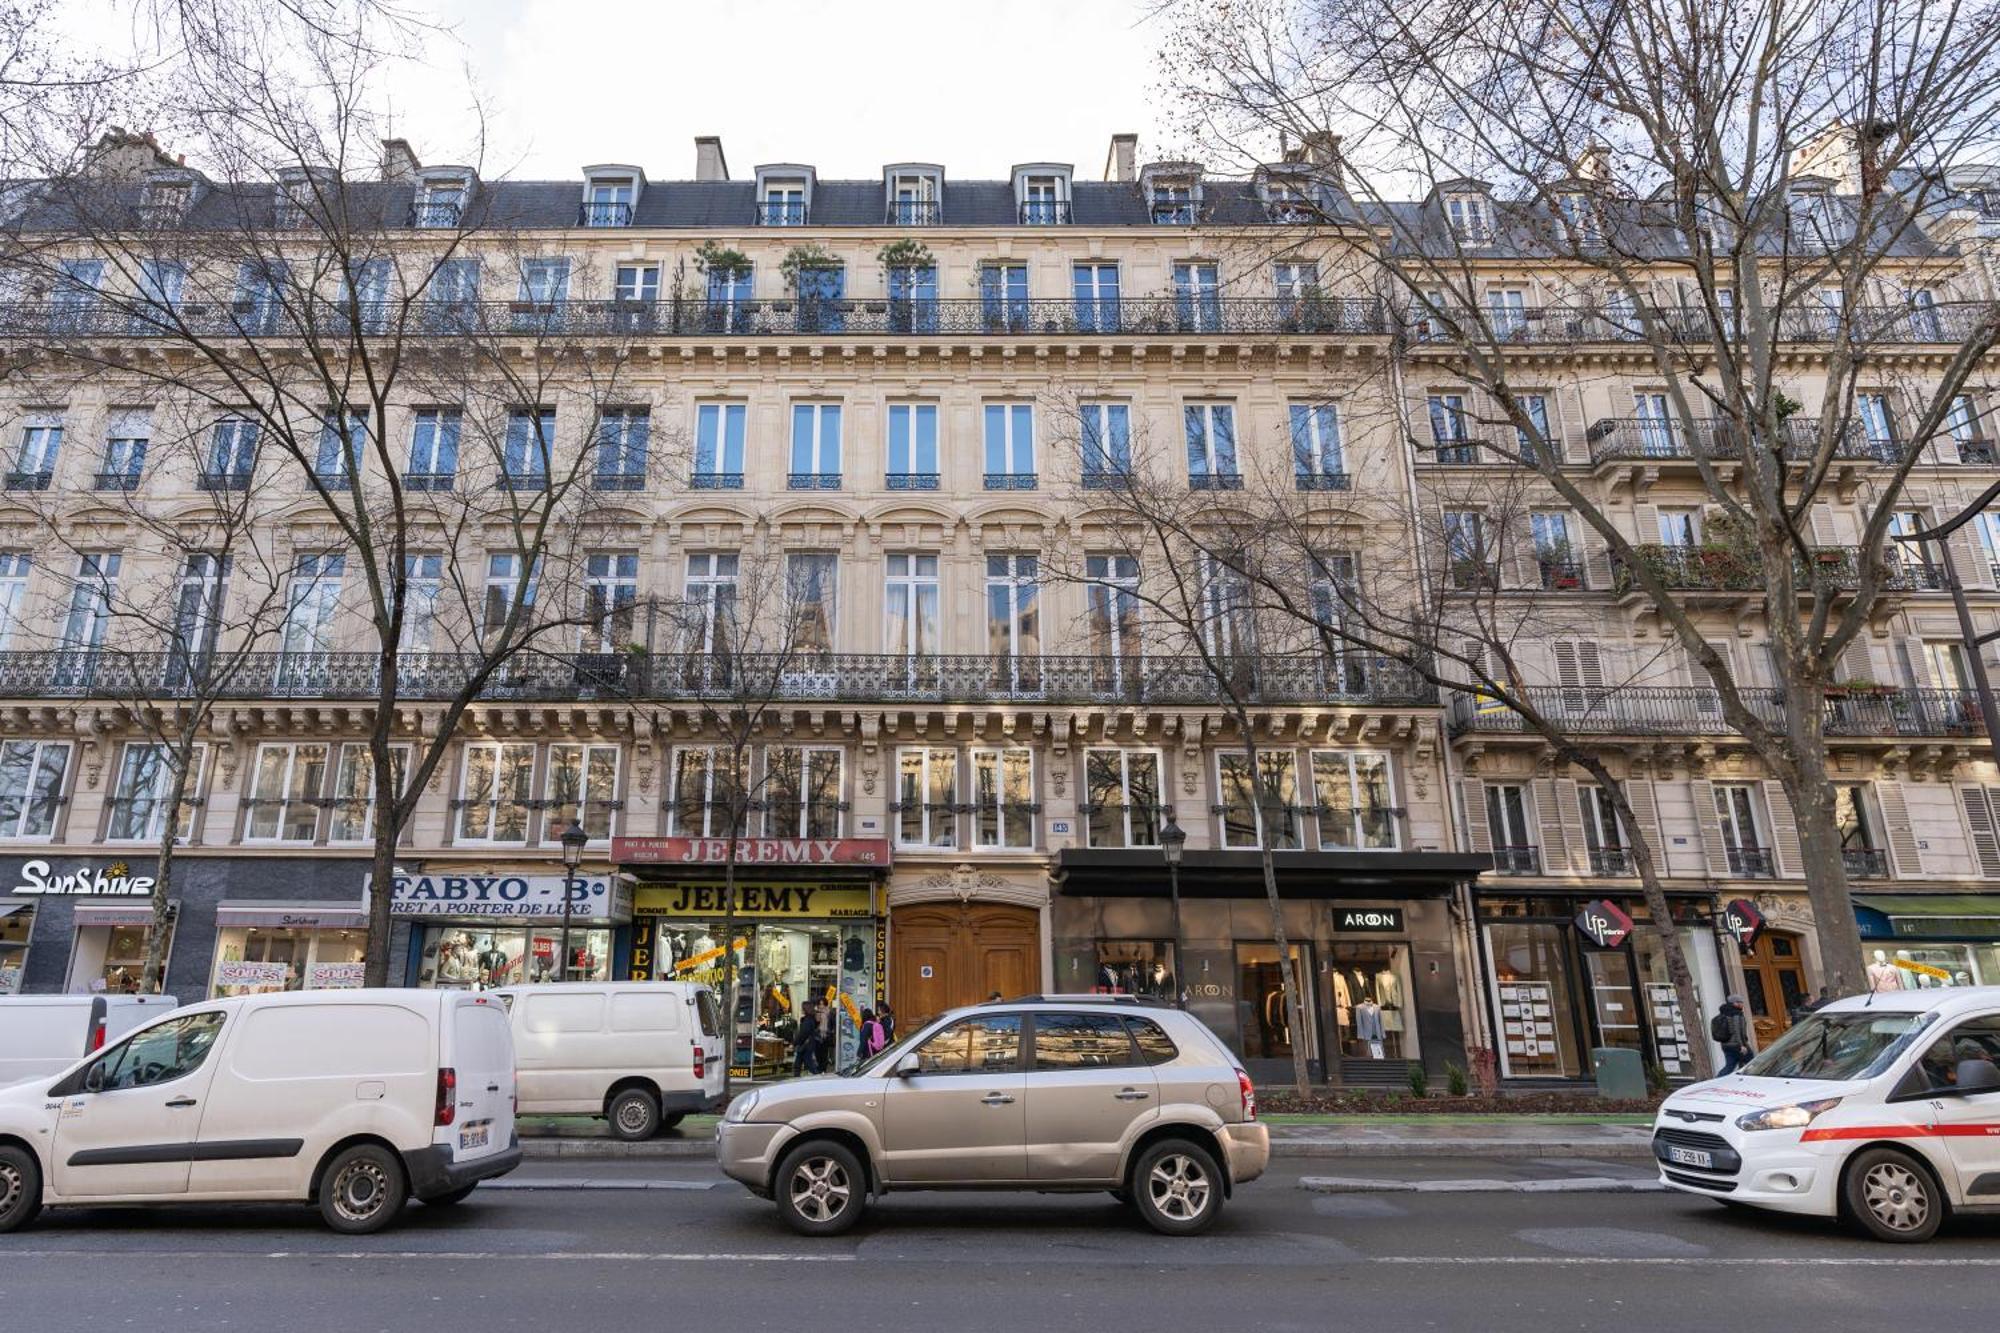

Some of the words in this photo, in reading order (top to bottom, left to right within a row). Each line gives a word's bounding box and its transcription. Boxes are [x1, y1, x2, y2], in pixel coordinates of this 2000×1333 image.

[682, 839, 841, 863] JEREMY
[391, 877, 528, 900] FABYO
[561, 879, 589, 900] B
[672, 886, 816, 912] JEREMY
[391, 902, 428, 913] RET
[430, 903, 441, 913] A
[446, 903, 512, 914] PORTER
[516, 903, 542, 914] DE
[546, 904, 591, 914] LUXE
[1344, 913, 1394, 926] AROON
[877, 931, 886, 1000] COSTUME
[1185, 984, 1232, 997] AROON
